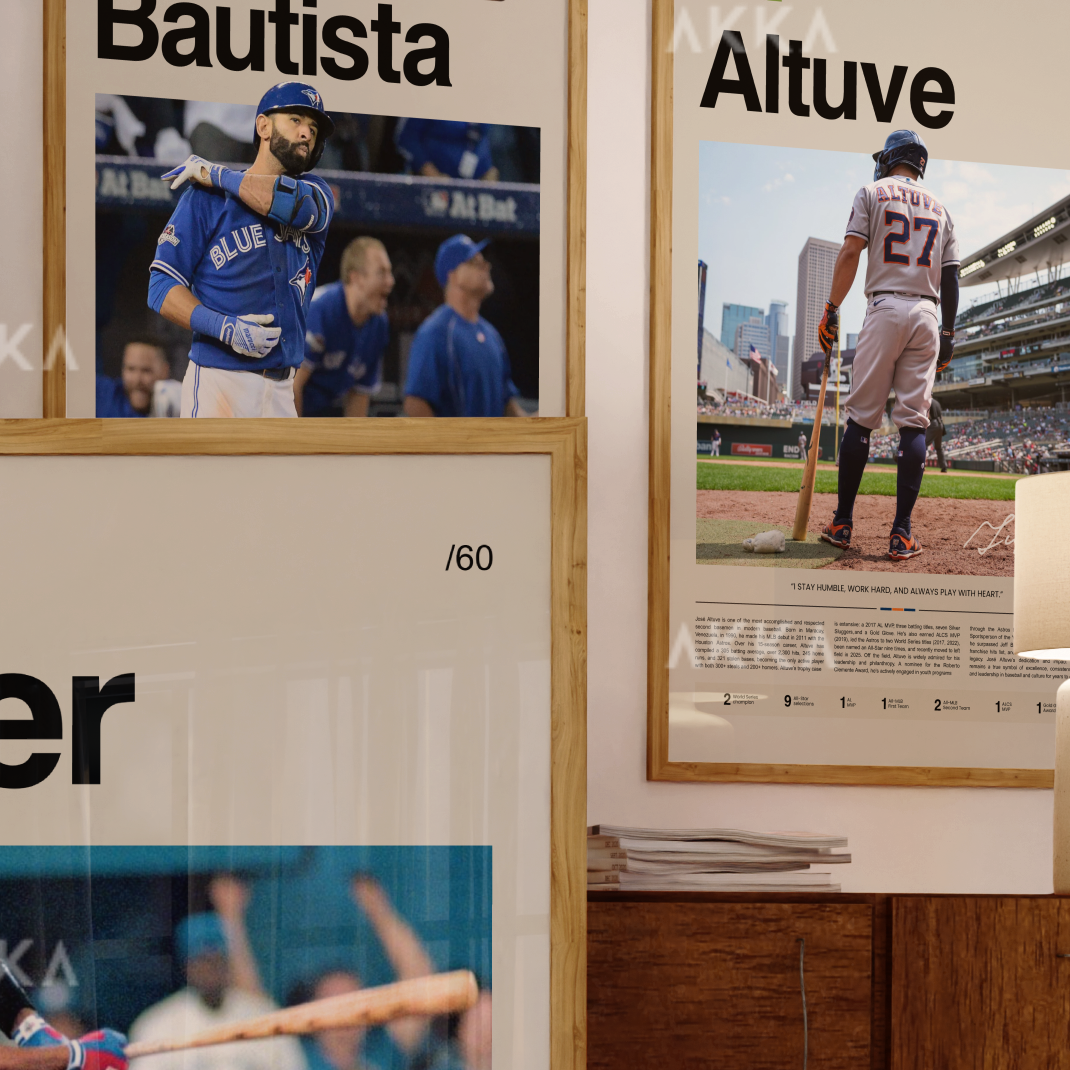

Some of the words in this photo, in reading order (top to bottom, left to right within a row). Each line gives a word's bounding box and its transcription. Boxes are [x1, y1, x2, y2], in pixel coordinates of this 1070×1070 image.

[97, 0, 453, 87] Bautista
[700, 30, 956, 129] Altuve
[876, 185, 943, 216] ALTUVE
[883, 209, 940, 268] 27
[209, 223, 267, 271] BLUE
[445, 544, 493, 571] /60
[797, 583, 815, 591] STAY
[816, 584, 846, 593] HUMBLE,
[847, 585, 869, 593] WORK
[871, 586, 892, 595] HARD,
[893, 587, 909, 595] AND
[910, 587, 939, 595] ALWAYS
[940, 588, 957, 596] PLAY
[958, 589, 976, 597] WITH
[977, 590, 1003, 598] HEART.”
[723, 693, 731, 706] 2
[784, 695, 792, 707] 9
[840, 696, 845, 708] 1
[882, 697, 887, 709] 1
[934, 699, 941, 711] 2
[995, 701, 1000, 713] 1
[1036, 702, 1041, 714] 1
